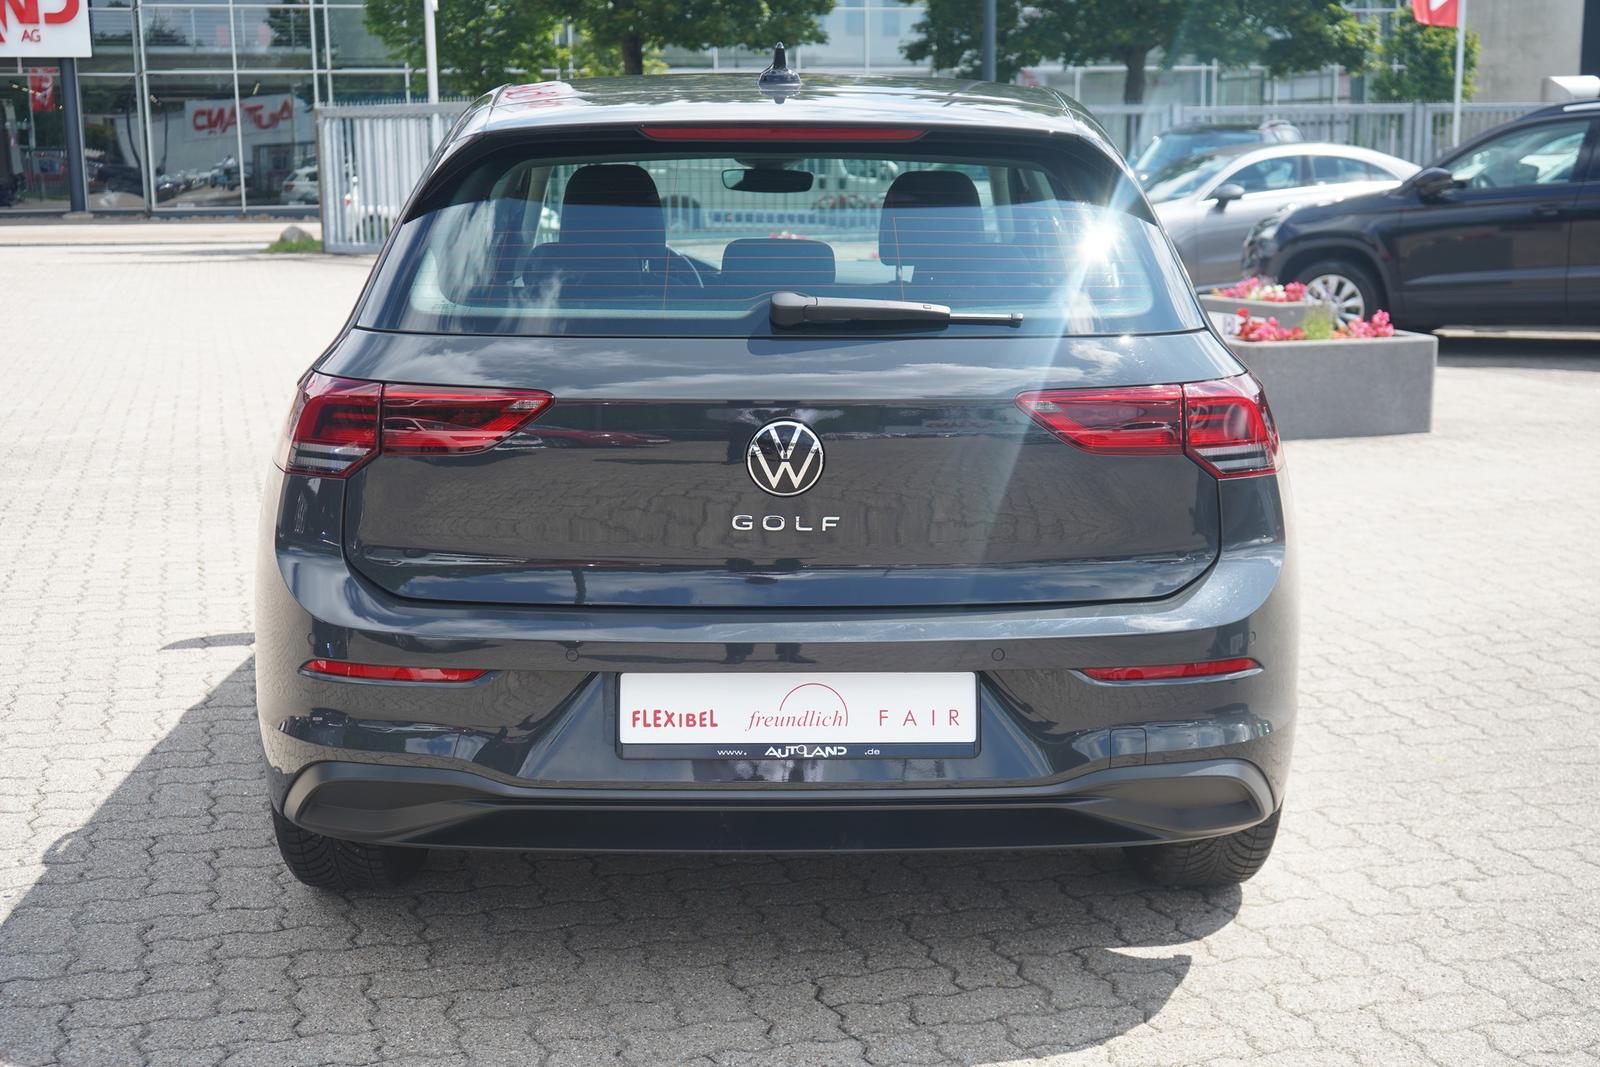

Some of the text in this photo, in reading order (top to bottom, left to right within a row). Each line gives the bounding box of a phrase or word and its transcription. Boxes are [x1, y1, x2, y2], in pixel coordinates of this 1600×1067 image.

[0, 0, 80, 43] ND
[21, 28, 42, 43] AG
[731, 514, 841, 532] GOLF
[631, 708, 960, 733] FLEXIBEL freundlich FAIR
[764, 744, 848, 758] AUTOLAND
[864, 748, 881, 756] .de
